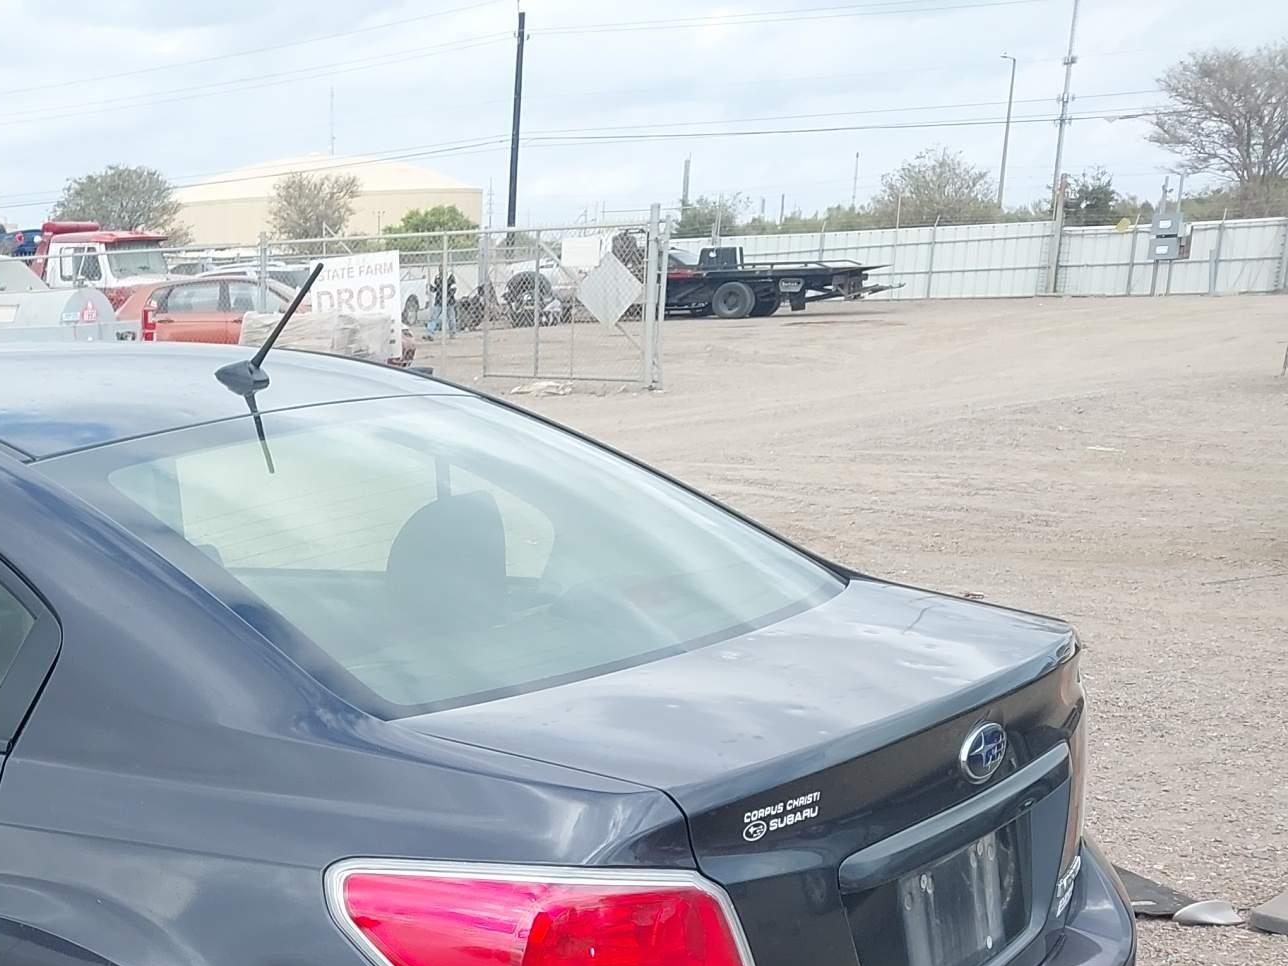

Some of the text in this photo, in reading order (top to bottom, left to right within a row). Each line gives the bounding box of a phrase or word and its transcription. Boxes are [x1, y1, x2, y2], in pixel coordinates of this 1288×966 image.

[318, 261, 394, 282] STATE FARM
[316, 283, 397, 313] DROP
[743, 791, 821, 823] CORPUS CHRISTI
[769, 805, 819, 831] SUBARU
